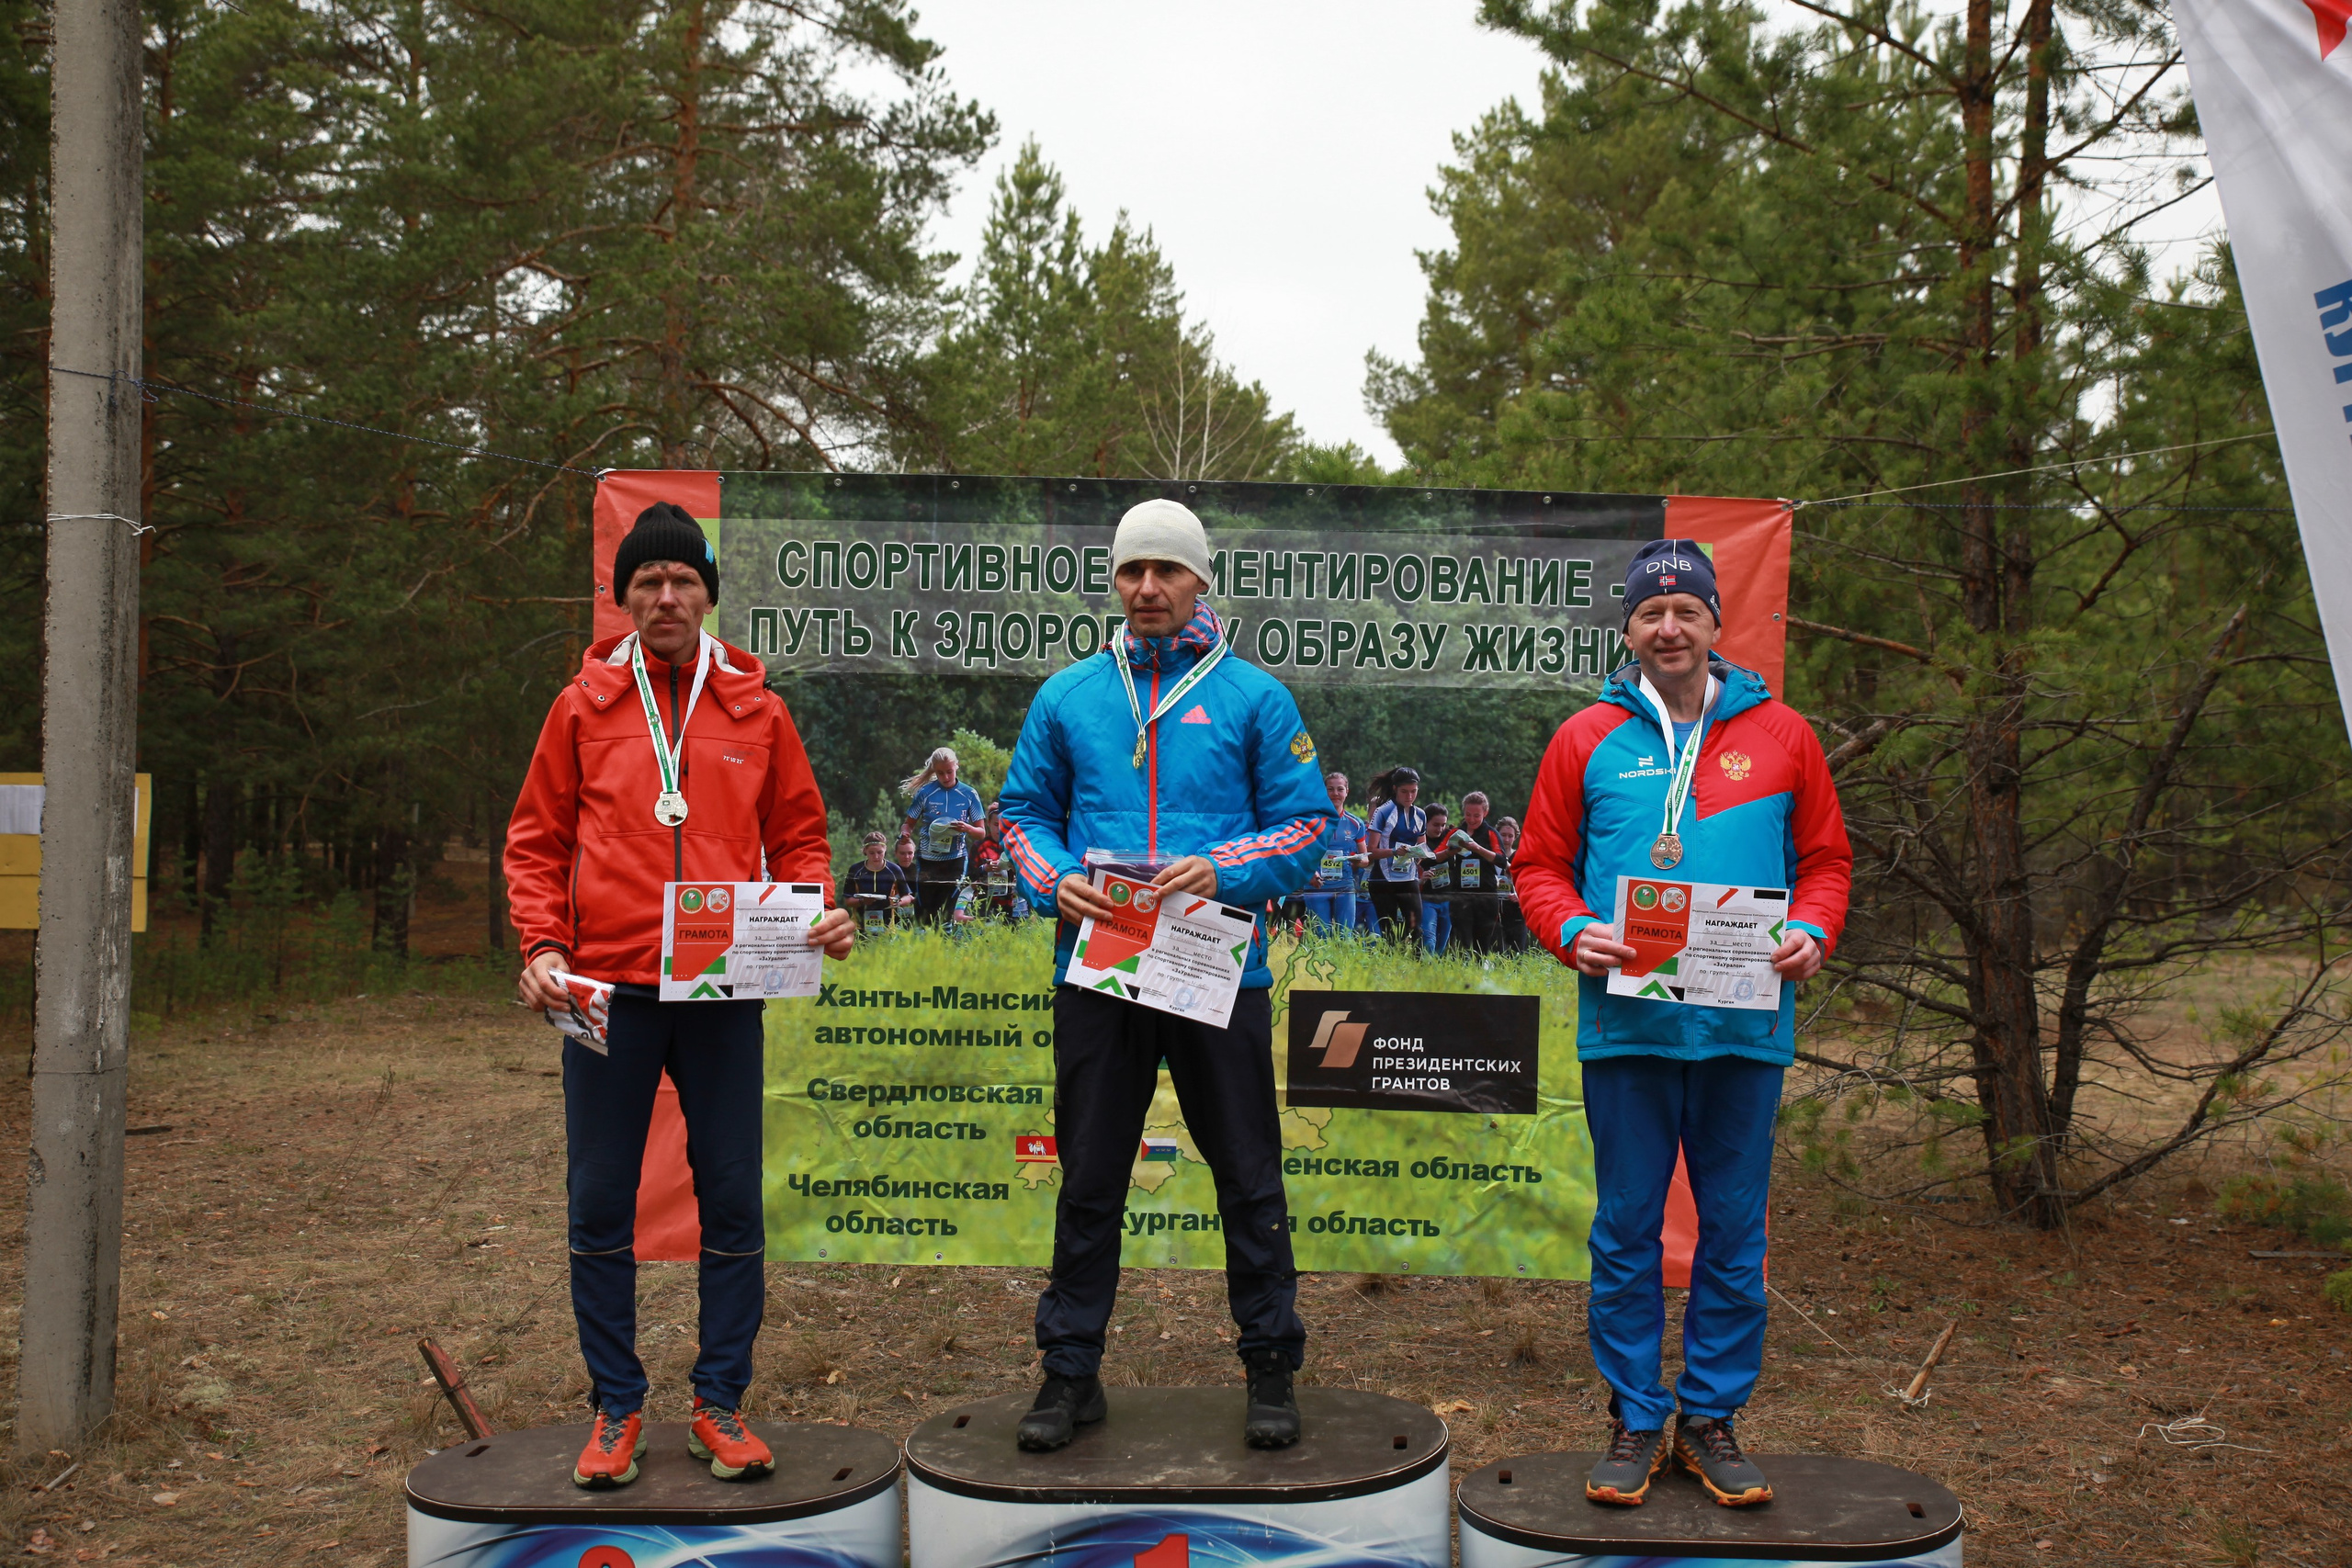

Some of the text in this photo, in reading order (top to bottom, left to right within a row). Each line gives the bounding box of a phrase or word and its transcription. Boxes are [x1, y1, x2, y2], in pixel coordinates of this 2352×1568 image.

[777, 540, 1109, 594] СПОРТИВНОЕ
[1198, 549, 1592, 607] ИЕНТИРОВАНИЕ
[1646, 552, 1691, 573] DNB
[750, 608, 872, 656] ПУТЬ
[891, 610, 918, 657] К
[1257, 617, 1449, 671] ОБРАЗУ
[1464, 625, 1634, 675] ЖИЗНИ
[1619, 767, 1677, 779] NORDSKI
[679, 930, 729, 939] ГРАМОТА
[1170, 925, 1221, 944] НАГРАЖДАЕТ
[1631, 925, 1682, 940] ГРАМОТА
[1705, 919, 1758, 929] НАГРАЖДАЕТ
[814, 983, 1057, 1011] Ханты-Мансий
[814, 1023, 1023, 1047] автономный
[1373, 1038, 1424, 1052] ФОНД
[1373, 1057, 1521, 1073] ПРЕЗИДЕНТСКИХ
[807, 1077, 1043, 1108] Свердловская
[1372, 1077, 1451, 1090] ГРАНТОВ
[853, 1114, 987, 1140] область
[1283, 1156, 1543, 1183] енская область
[788, 1173, 1009, 1201] Челябинская
[825, 1210, 958, 1236] область
[1307, 1210, 1441, 1237] область
